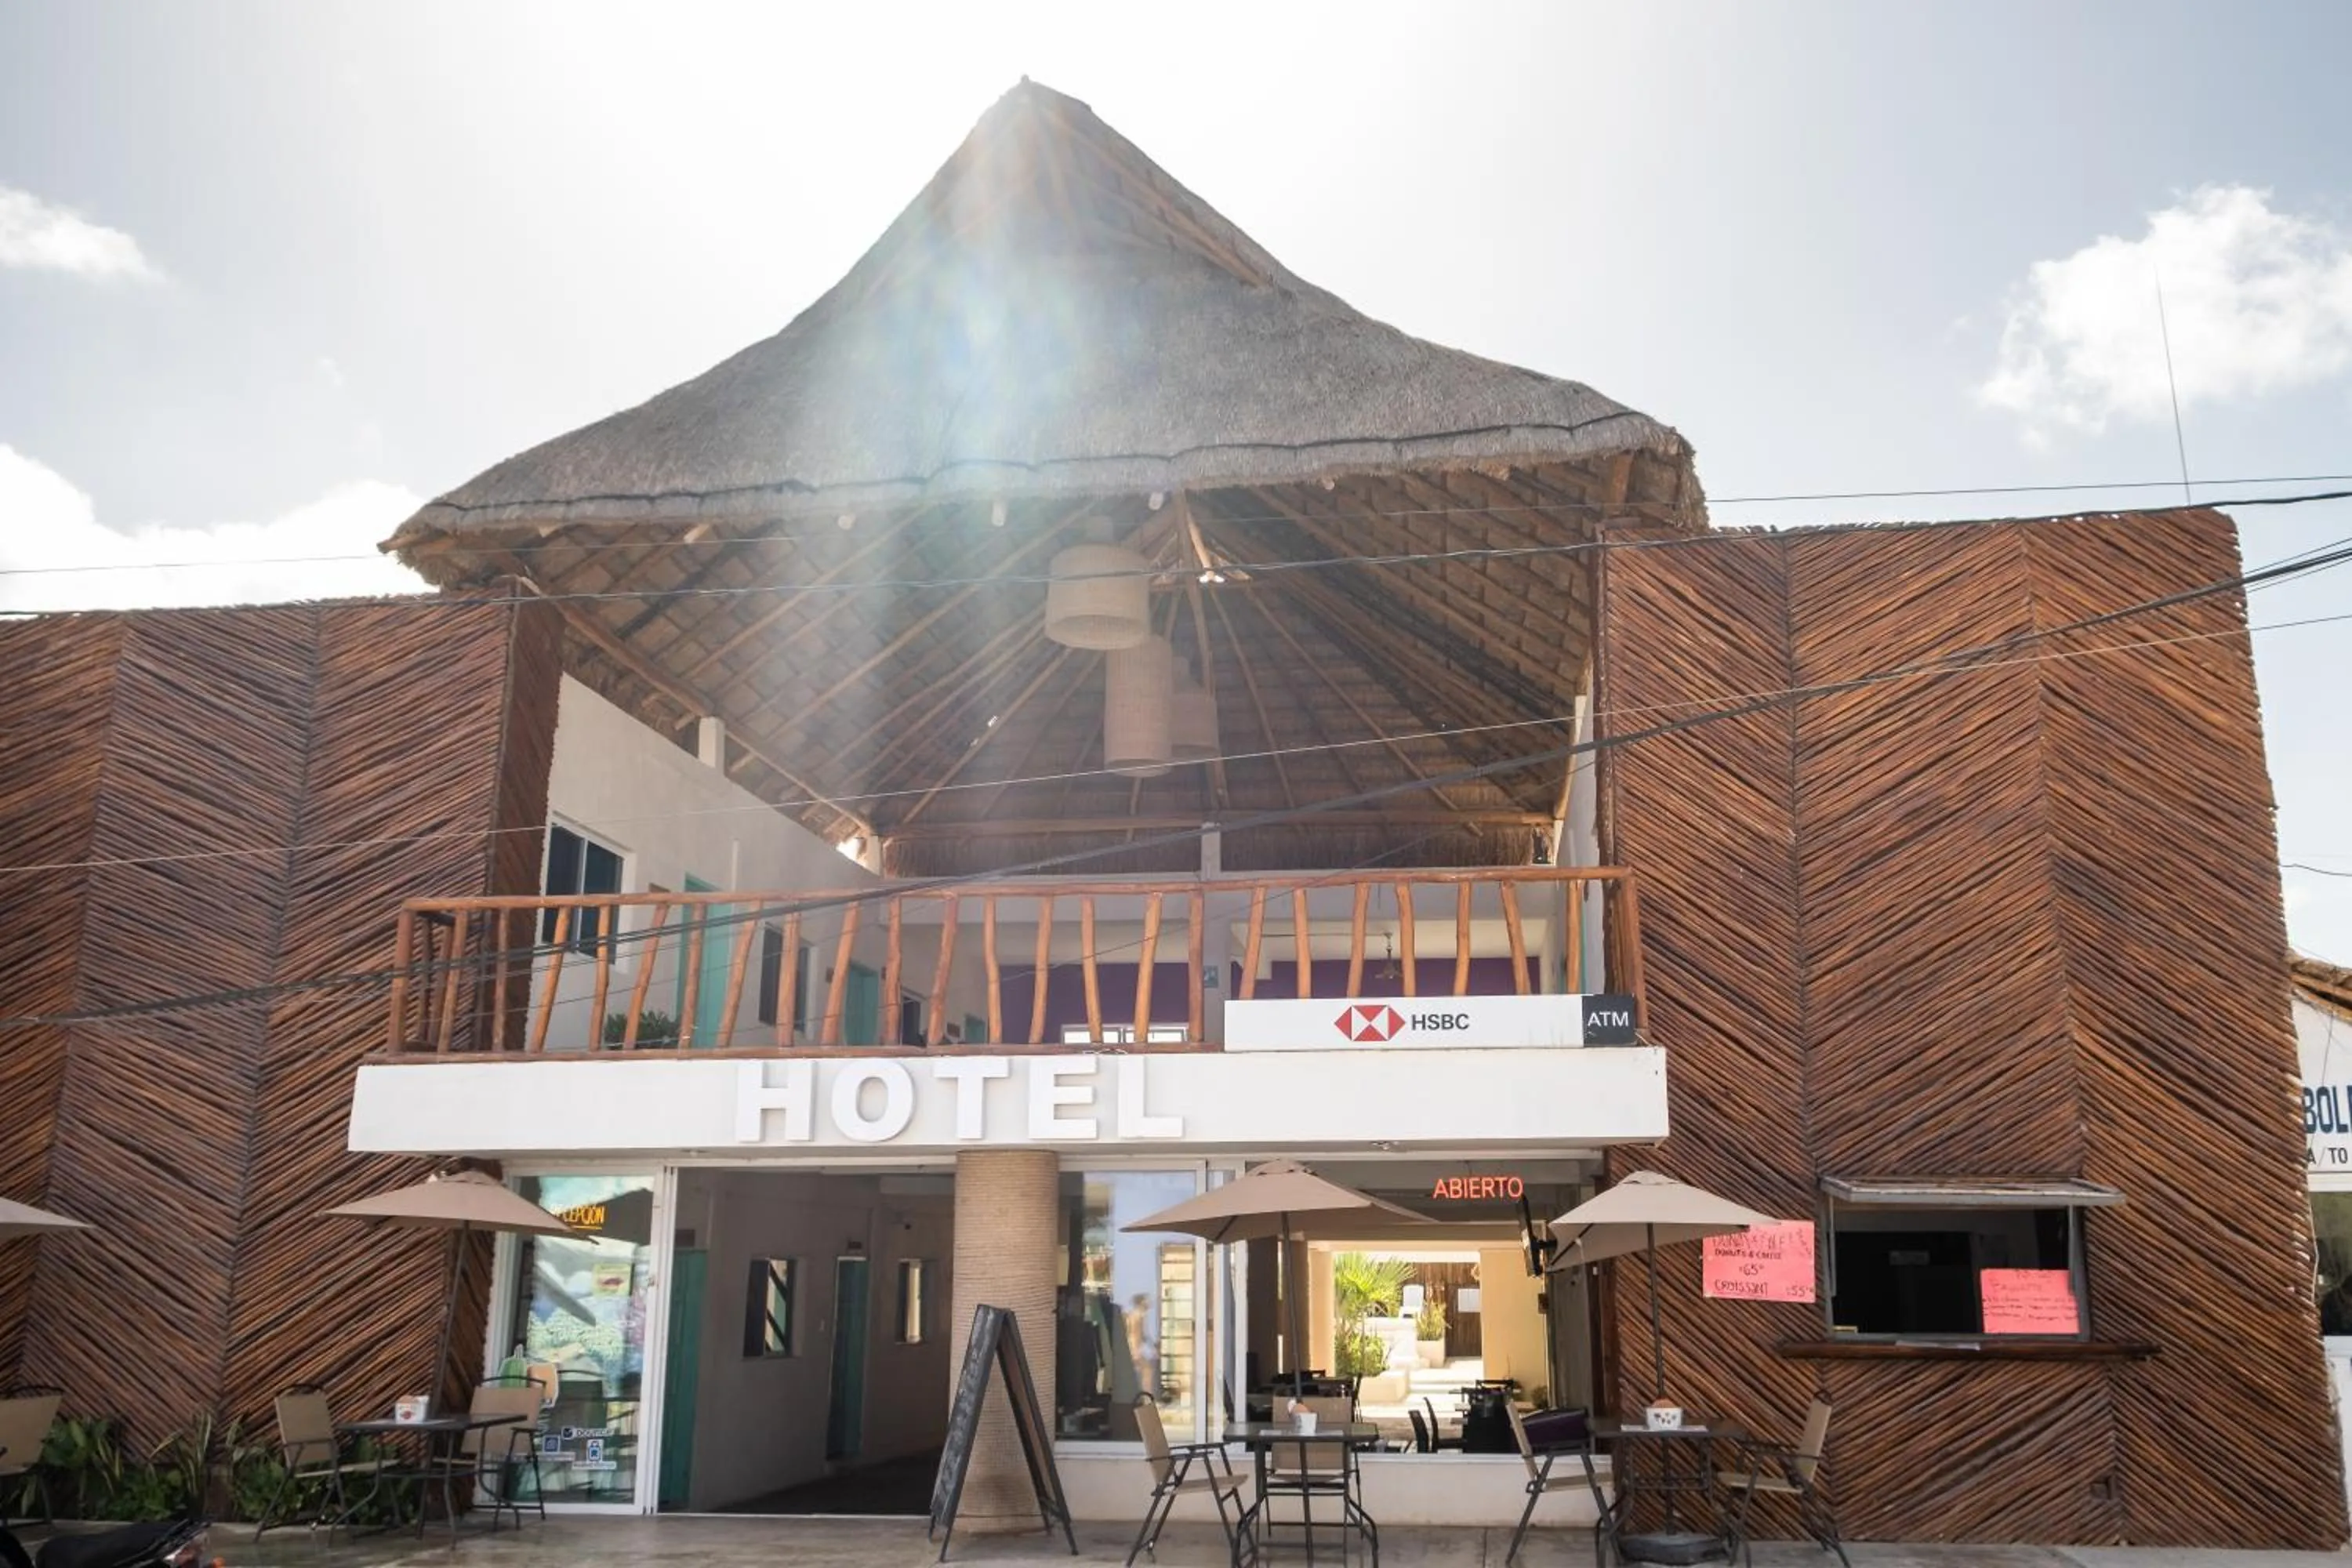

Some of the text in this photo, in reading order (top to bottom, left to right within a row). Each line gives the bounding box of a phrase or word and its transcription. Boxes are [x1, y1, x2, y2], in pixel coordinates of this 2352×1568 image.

[1410, 1013, 1471, 1031] HSBC
[1587, 1010, 1630, 1028] ATM
[735, 1055, 1185, 1142] HOTEL
[1432, 1176, 1524, 1200] ABIERTO
